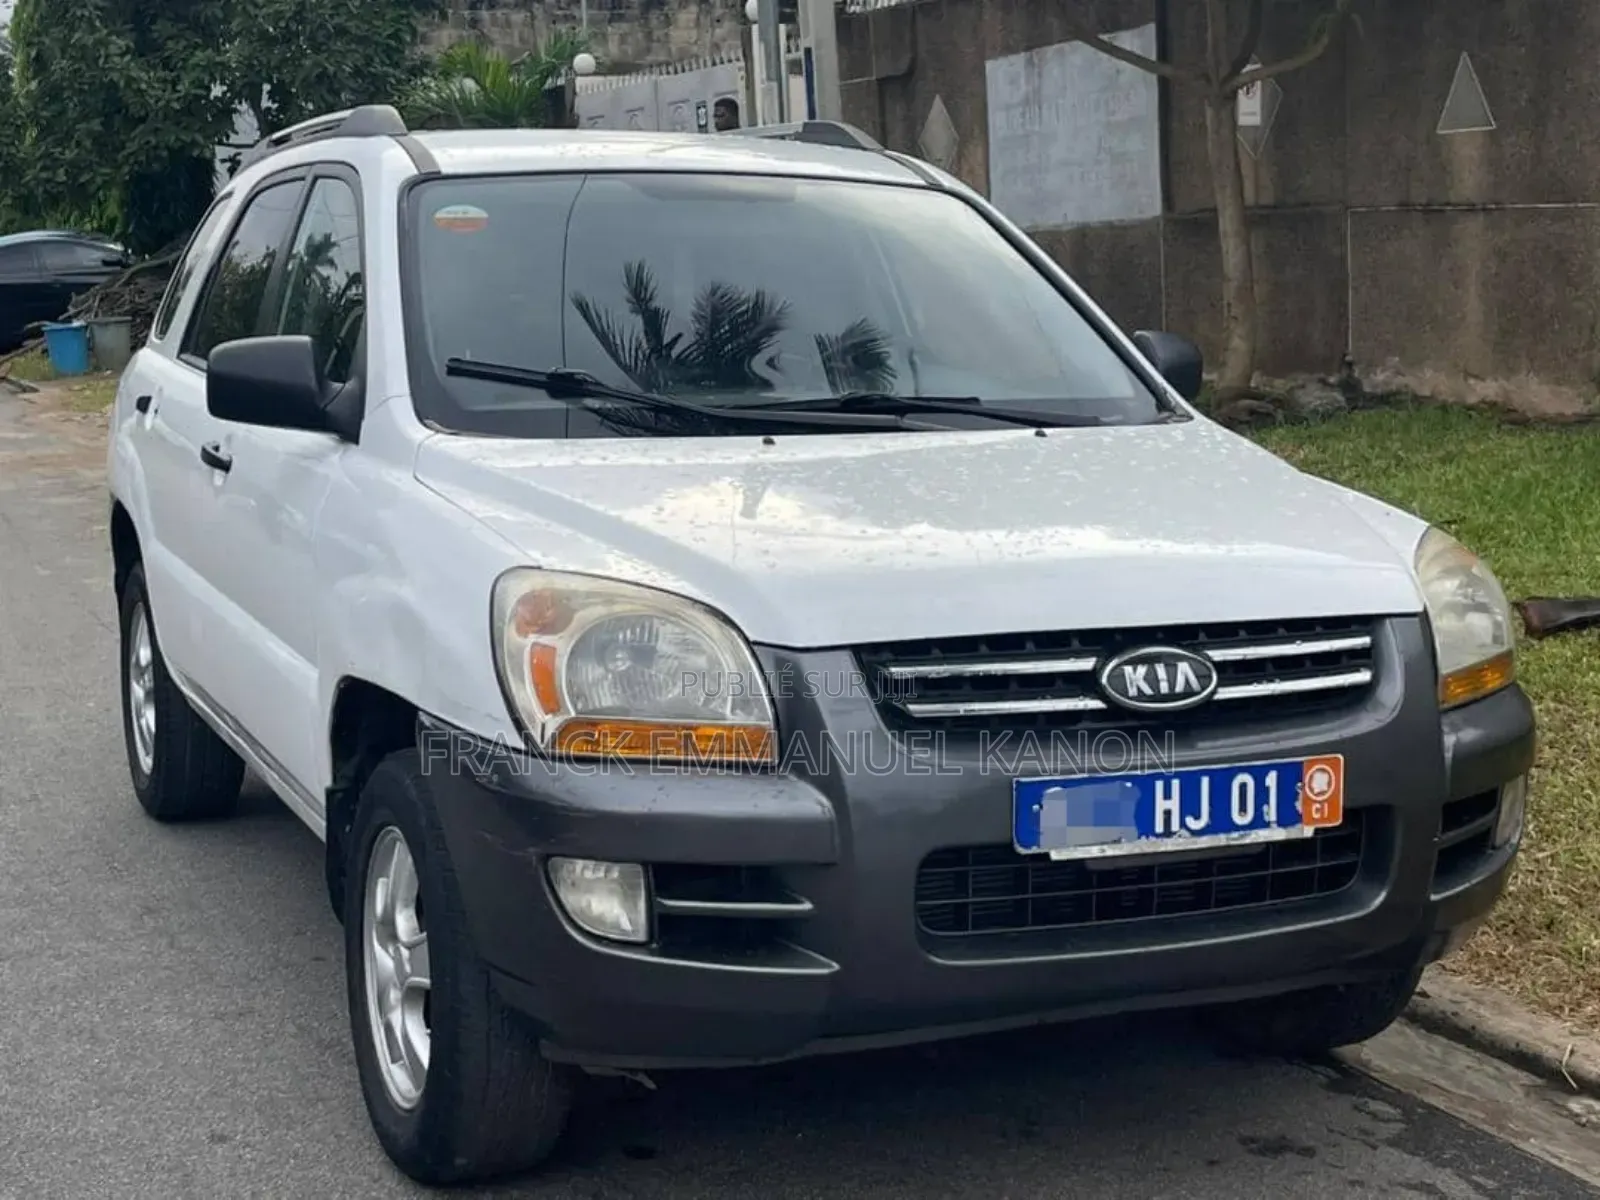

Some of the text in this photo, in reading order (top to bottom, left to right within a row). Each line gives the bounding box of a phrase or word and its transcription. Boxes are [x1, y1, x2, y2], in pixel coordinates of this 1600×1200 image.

[1122, 661, 1202, 698] KIA
[1154, 770, 1278, 834] HJ 01
[1311, 802, 1329, 819] CI
